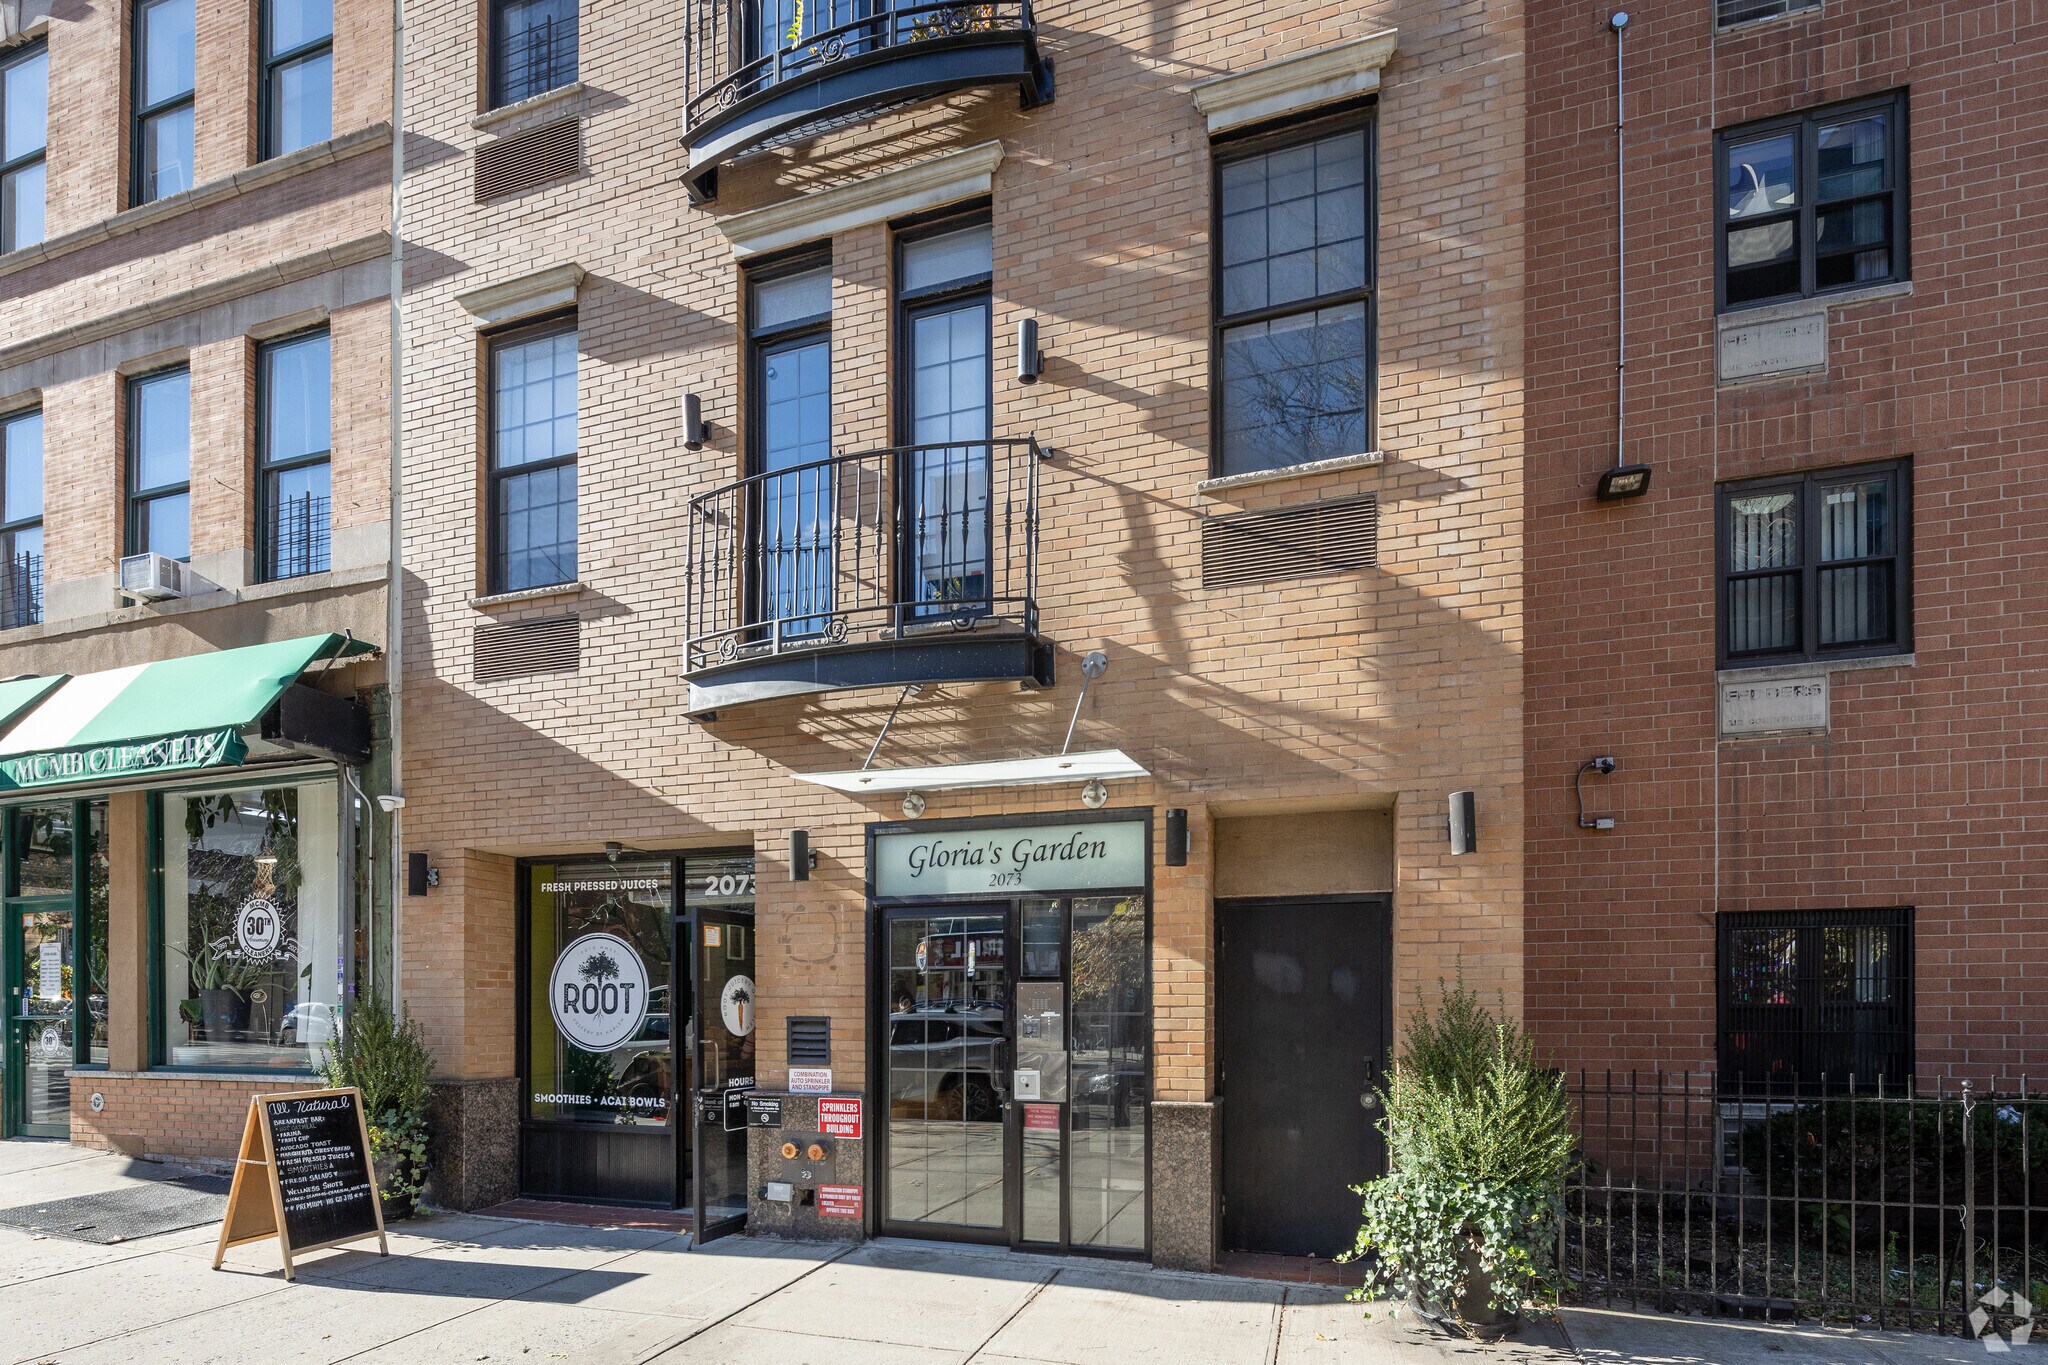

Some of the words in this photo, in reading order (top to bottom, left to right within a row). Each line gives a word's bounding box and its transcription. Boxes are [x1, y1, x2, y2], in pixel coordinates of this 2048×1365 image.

[15, 752, 84, 783] MCMB
[89, 733, 217, 773] CLEANERS
[908, 839, 1003, 878] Gloria's
[1011, 831, 1107, 873] Garden
[541, 882, 571, 892] FRESH
[574, 880, 618, 891] PRESSED
[620, 879, 658, 890] JUICES
[988, 871, 1022, 887] 2073
[249, 900, 270, 910] MCMB
[243, 945, 273, 957] CLEANERS
[563, 982, 635, 1015] ROOT
[728, 1077, 754, 1087] HOURS
[268, 1101, 290, 1115] All
[293, 1095, 350, 1113] Natural
[534, 1093, 592, 1105] SMOOTHIES
[600, 1095, 627, 1106] ACAI
[629, 1096, 666, 1108] BOWLS
[821, 1102, 858, 1113] SPRINKLERS
[273, 1117, 309, 1126] BREAKFAST
[820, 1113, 859, 1124] THROUGHOUT
[280, 1130, 302, 1138] FARINA
[826, 1123, 854, 1134] BUILDING
[280, 1143, 309, 1152] AVOCADO
[310, 1139, 332, 1148] TOAST
[282, 1158, 302, 1166] FRESH
[302, 1155, 327, 1164] PRESSED
[327, 1152, 350, 1160] JUICES
[287, 1163, 329, 1175] SMOOTHIES
[285, 1177, 307, 1185] FRESH
[309, 1171, 333, 1182] SALADS
